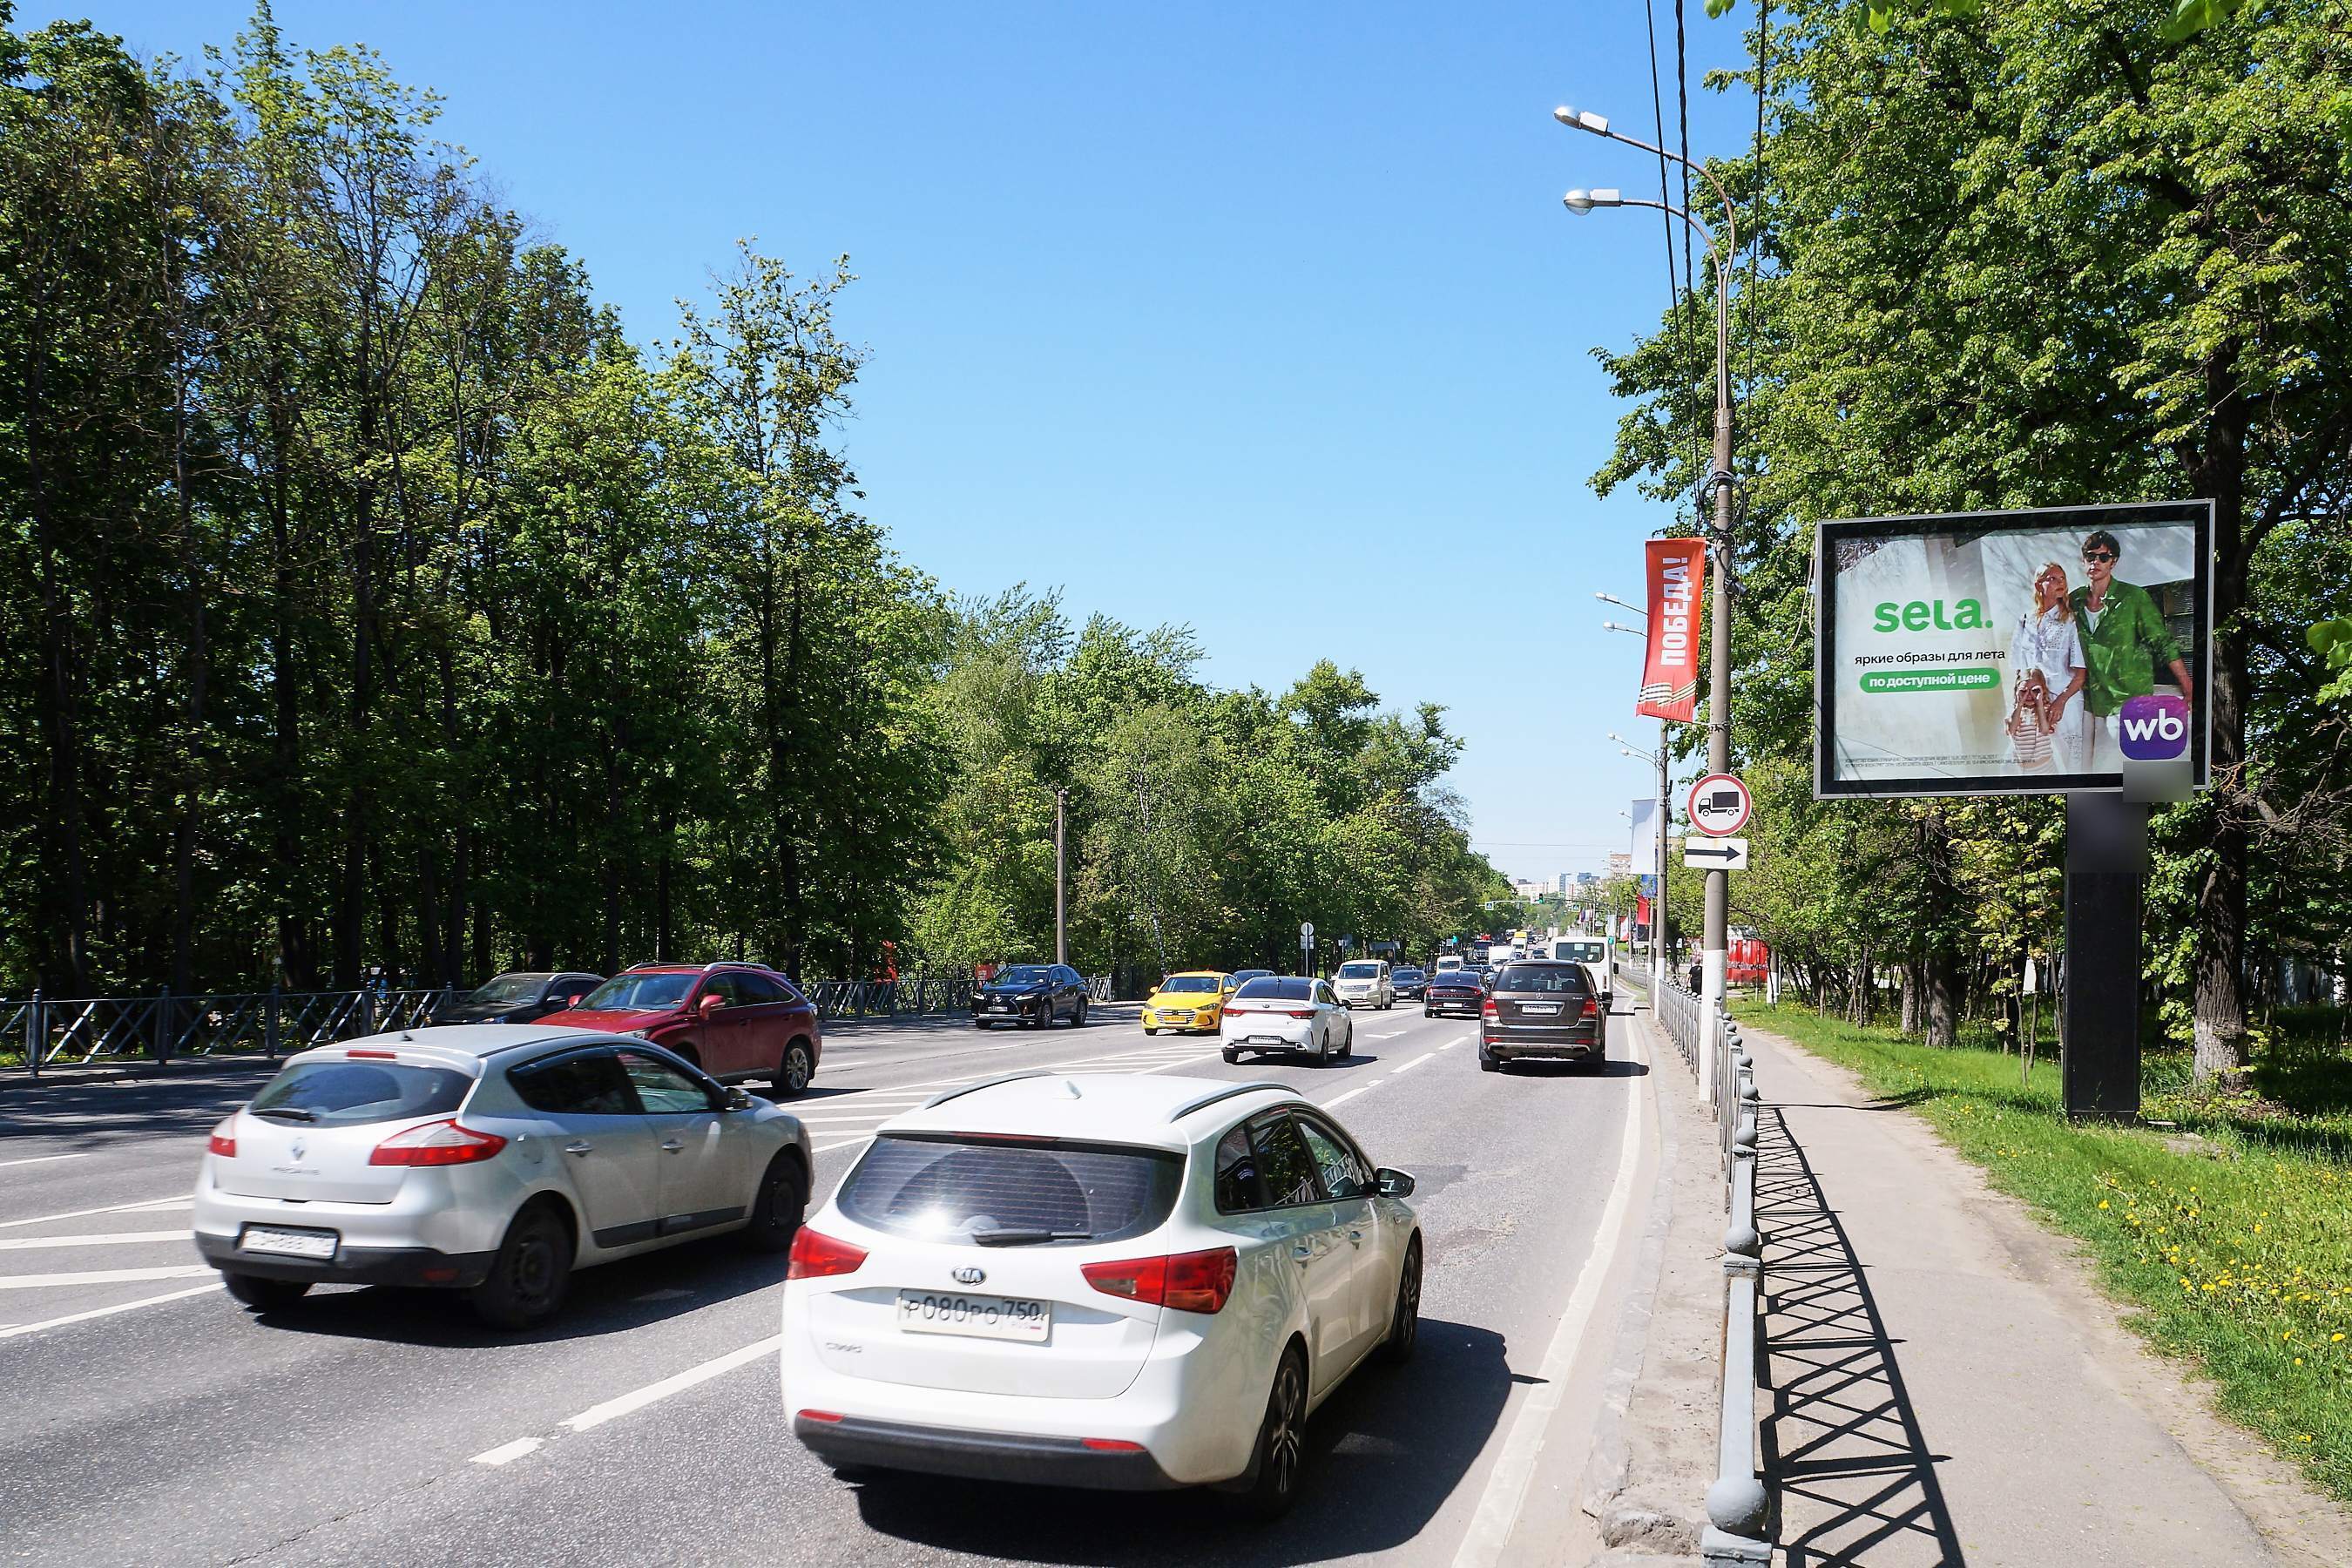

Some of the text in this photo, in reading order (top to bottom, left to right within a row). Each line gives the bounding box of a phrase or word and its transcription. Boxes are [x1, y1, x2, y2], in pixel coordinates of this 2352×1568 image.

[1660, 557, 1693, 666] ПОБЕДА!
[1855, 650, 2006, 667] яркие образы для лета
[1869, 672, 1990, 688] по доступной цене
[2124, 708, 2184, 741] wb
